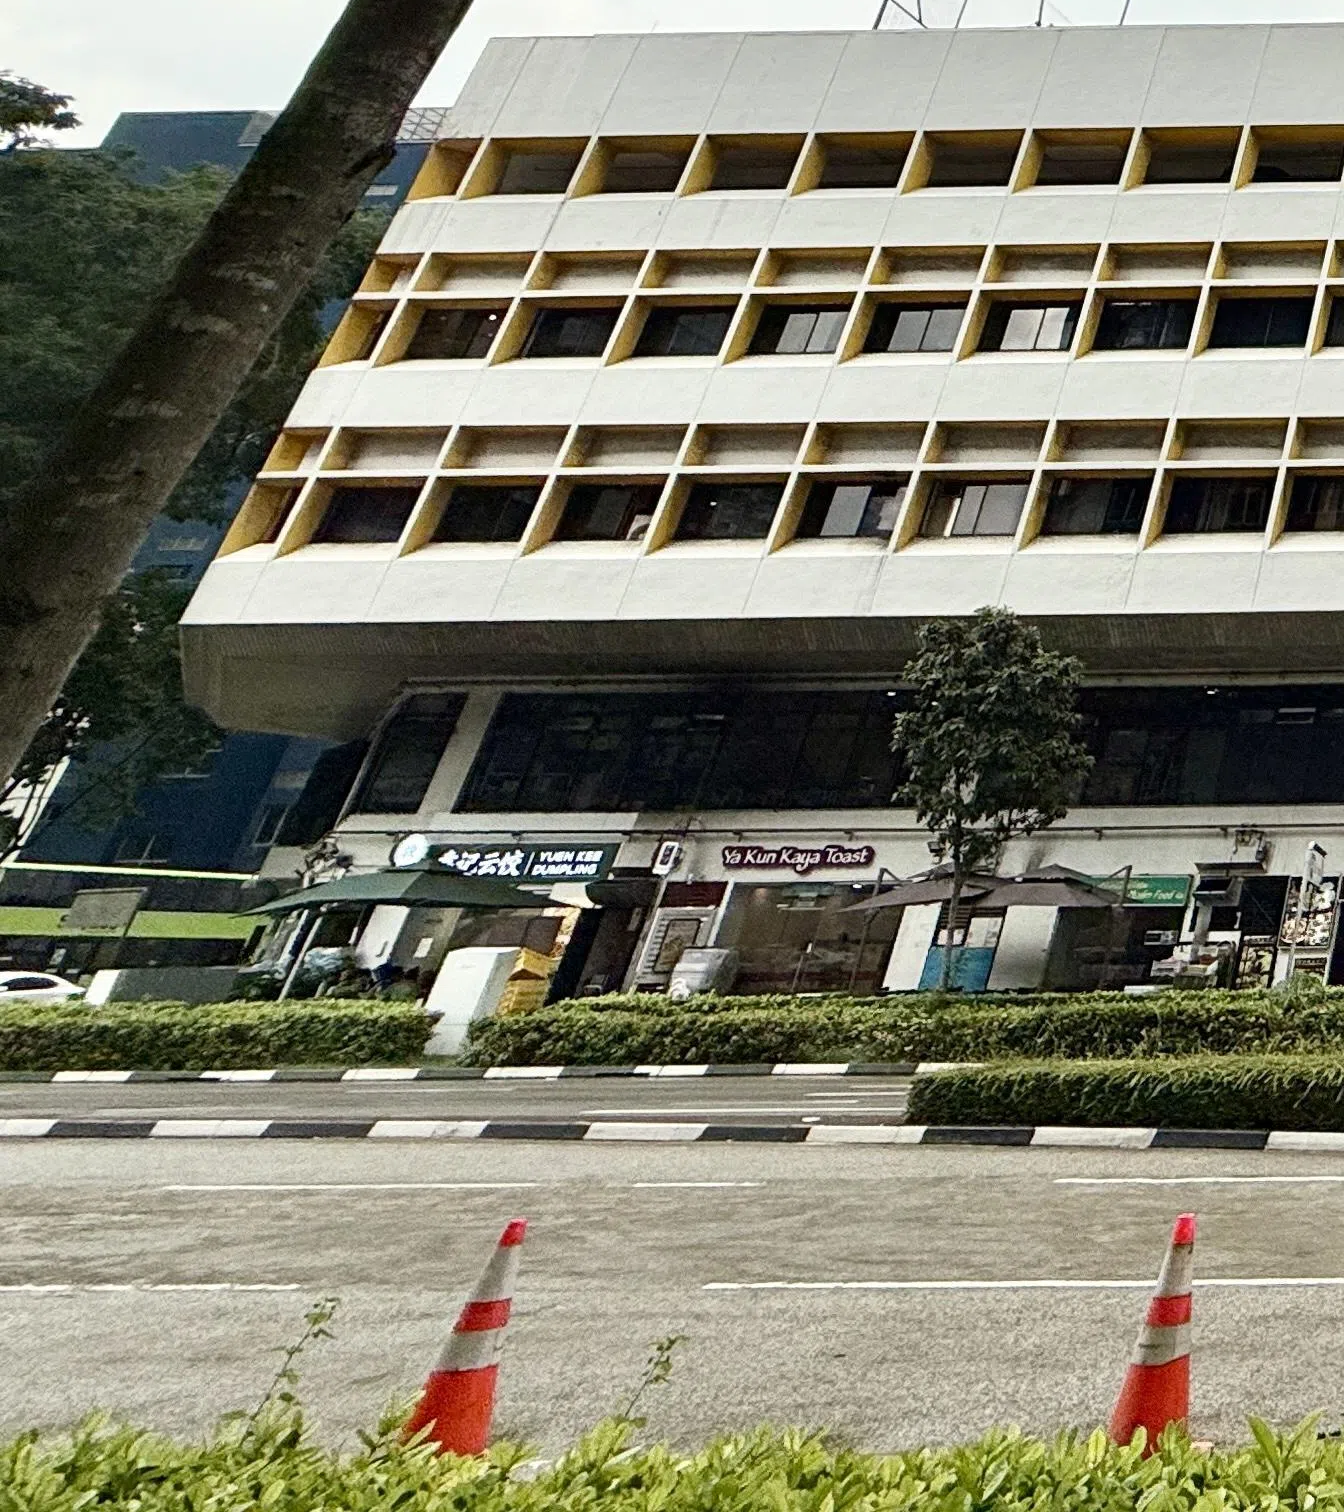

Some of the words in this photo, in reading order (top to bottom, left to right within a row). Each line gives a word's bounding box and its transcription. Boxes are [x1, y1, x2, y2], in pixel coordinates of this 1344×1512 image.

[722, 849, 741, 864] Ya
[743, 851, 777, 864] Kun
[779, 852, 821, 872] Kaya
[825, 847, 869, 863] Toast
[531, 863, 598, 876] DUMPLING
